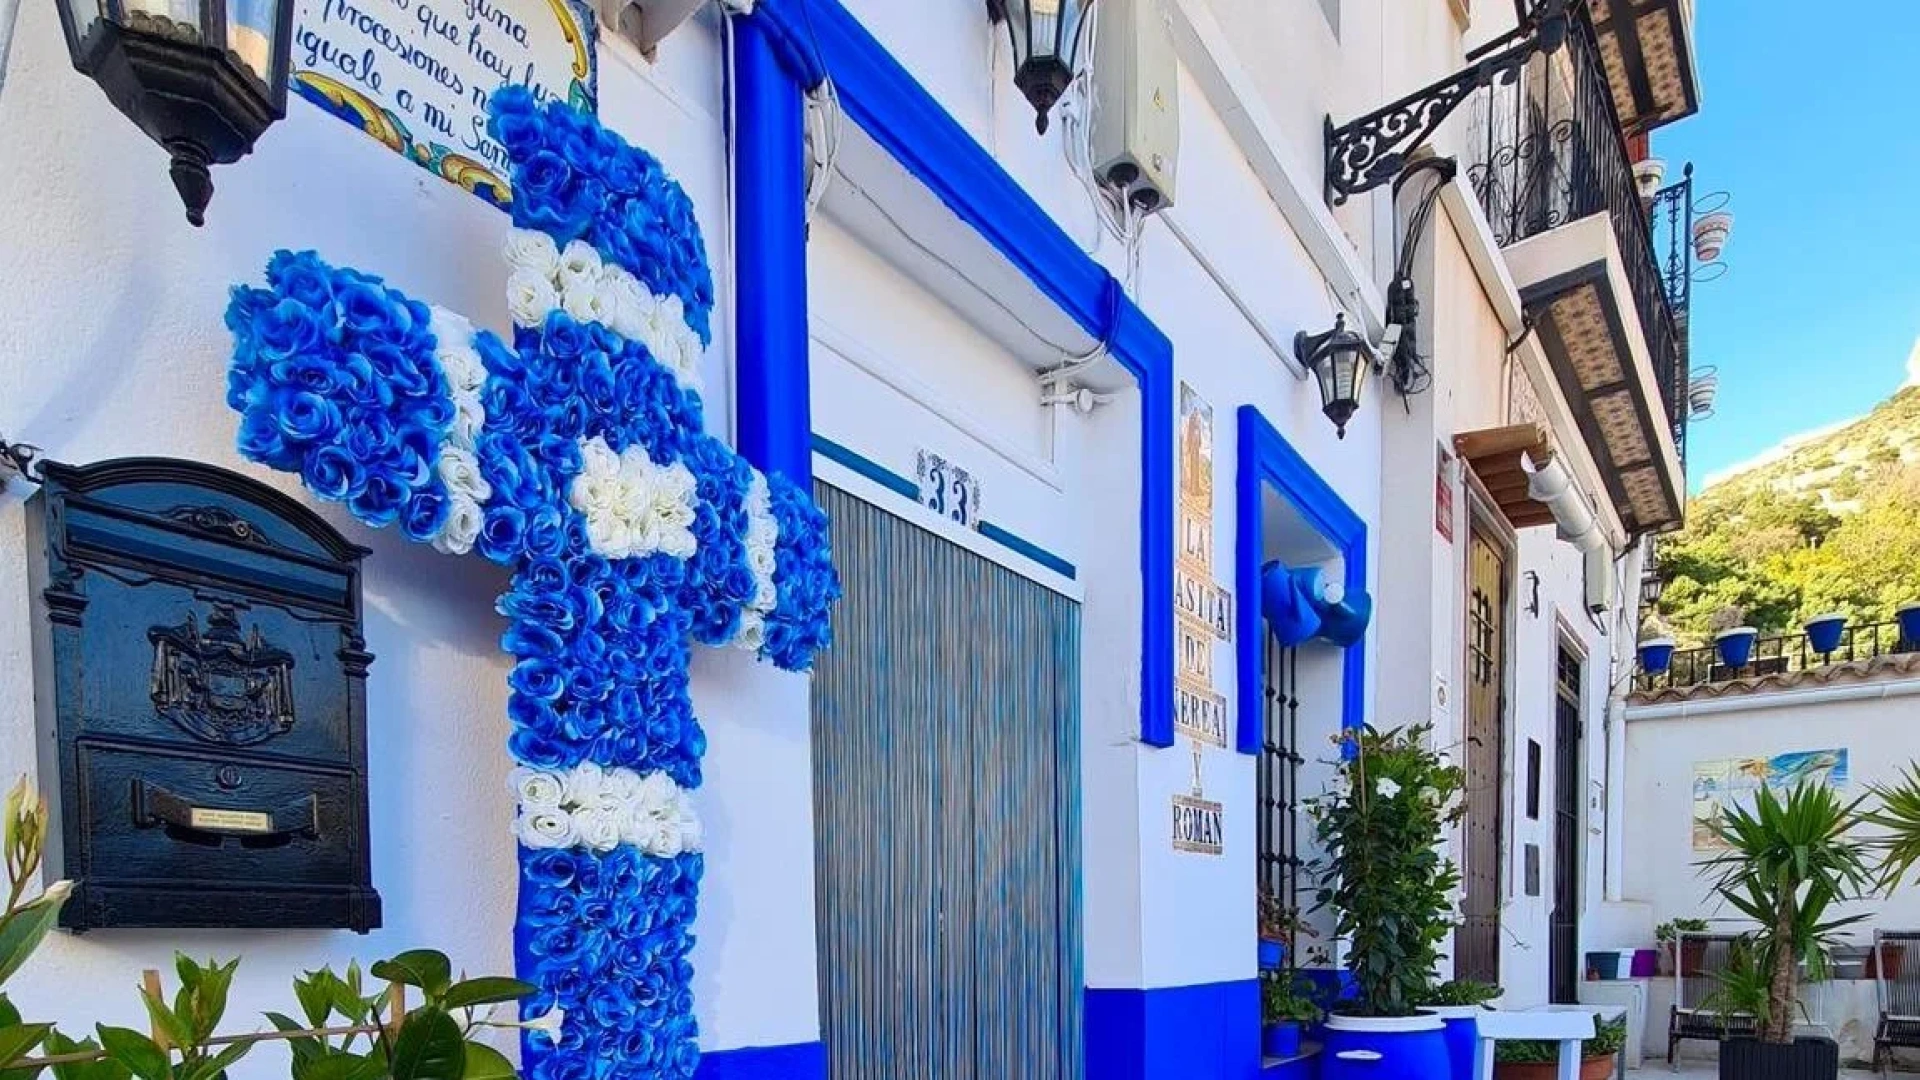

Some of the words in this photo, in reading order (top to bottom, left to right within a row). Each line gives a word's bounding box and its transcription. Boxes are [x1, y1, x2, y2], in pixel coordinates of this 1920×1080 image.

[296, 9, 383, 95] iguale
[396, 89, 414, 113] a
[424, 102, 454, 138] mi
[417, 5, 461, 45] que
[468, 23, 513, 87] hay
[928, 467, 968, 526] 33
[1186, 517, 1205, 562] LA
[1174, 571, 1226, 632] ASITA
[1186, 635, 1204, 676] DE
[1173, 804, 1223, 845] ROMAN
